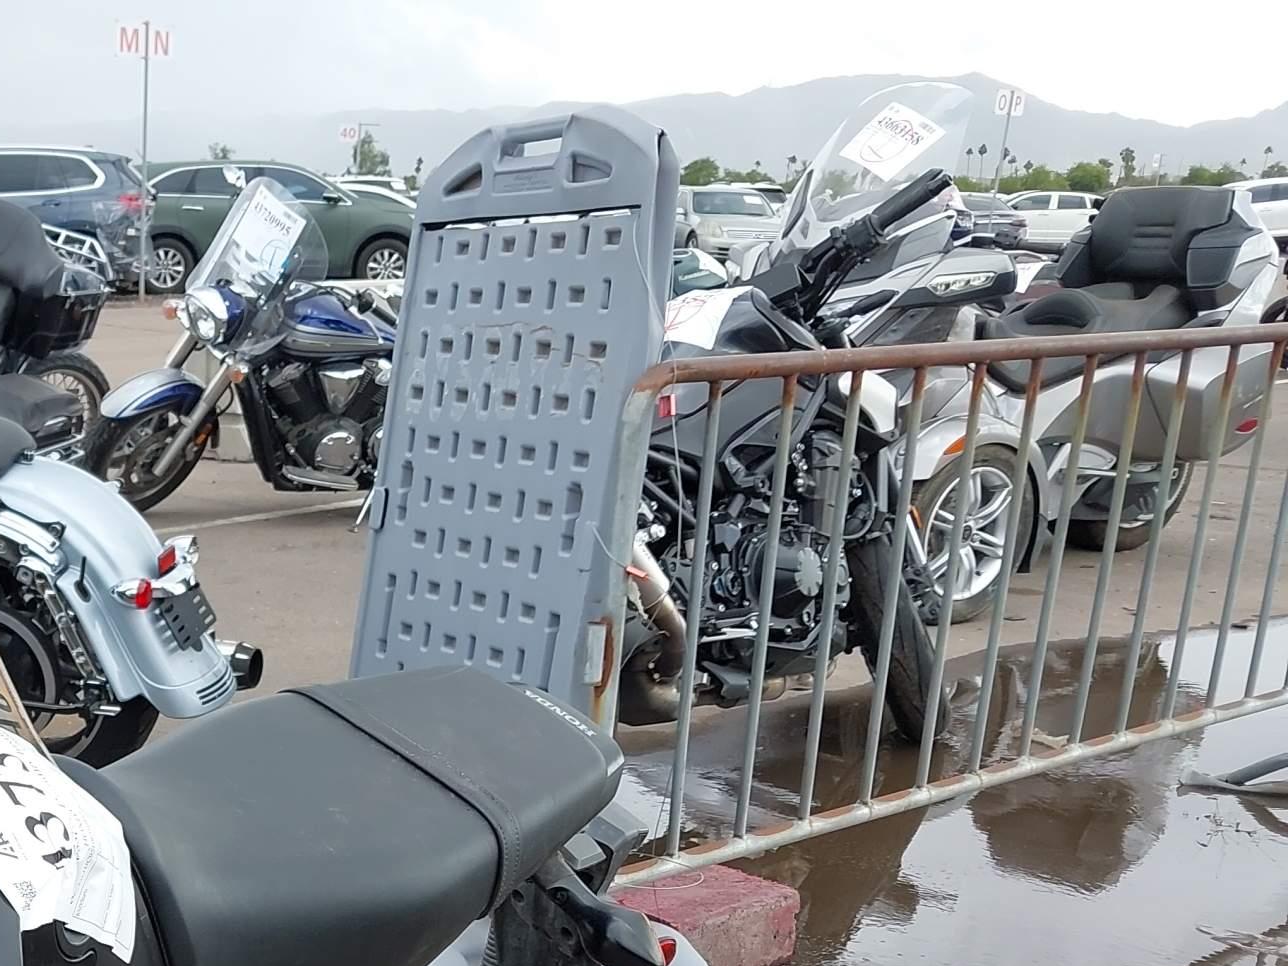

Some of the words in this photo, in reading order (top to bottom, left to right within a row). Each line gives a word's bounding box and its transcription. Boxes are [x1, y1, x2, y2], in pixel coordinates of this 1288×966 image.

[119, 26, 140, 54] M
[153, 29, 171, 57] N
[339, 126, 357, 140] 40
[523, 688, 598, 737] HONDA
